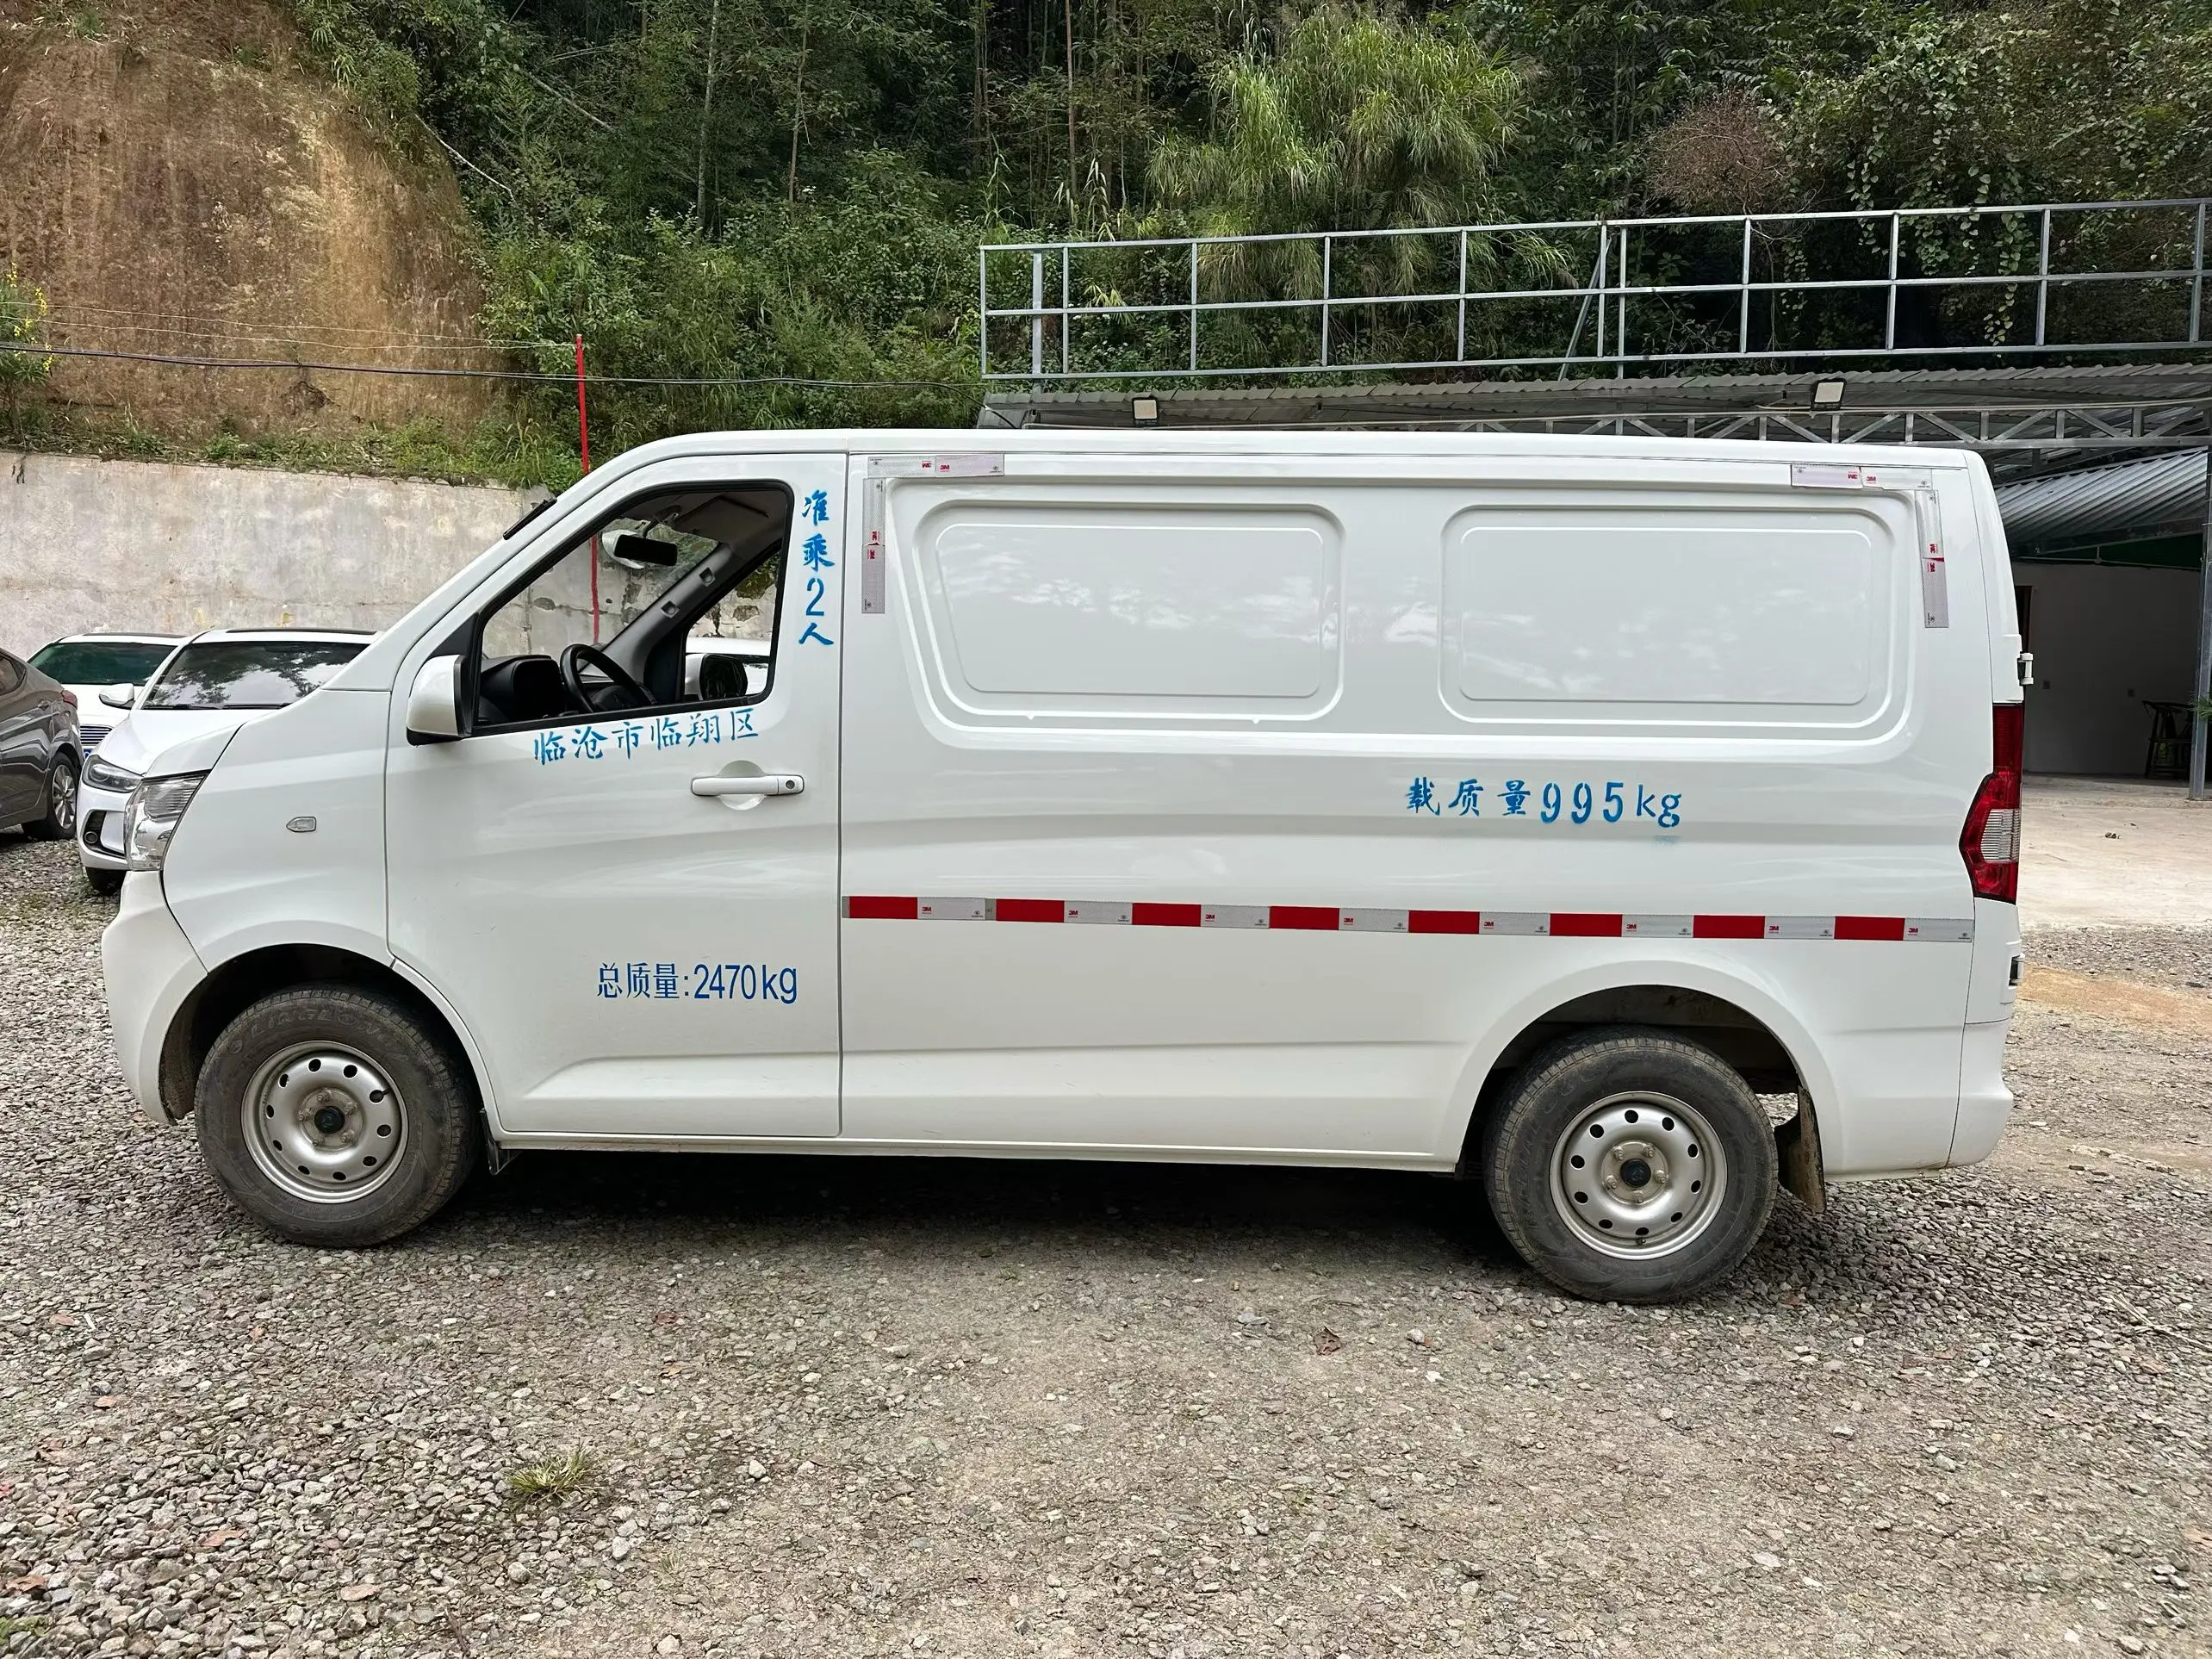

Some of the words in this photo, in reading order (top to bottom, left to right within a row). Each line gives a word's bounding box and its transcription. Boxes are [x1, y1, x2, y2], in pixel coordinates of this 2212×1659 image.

[872, 531, 878, 540] 3M
[1929, 544, 1936, 553] 3M
[869, 550, 875, 560] 3M
[798, 488, 835, 647] 准乘2人
[1929, 562, 1936, 572] 3M
[533, 707, 758, 766] 临沧市临翔区
[1407, 776, 1683, 828] 载质量995kg
